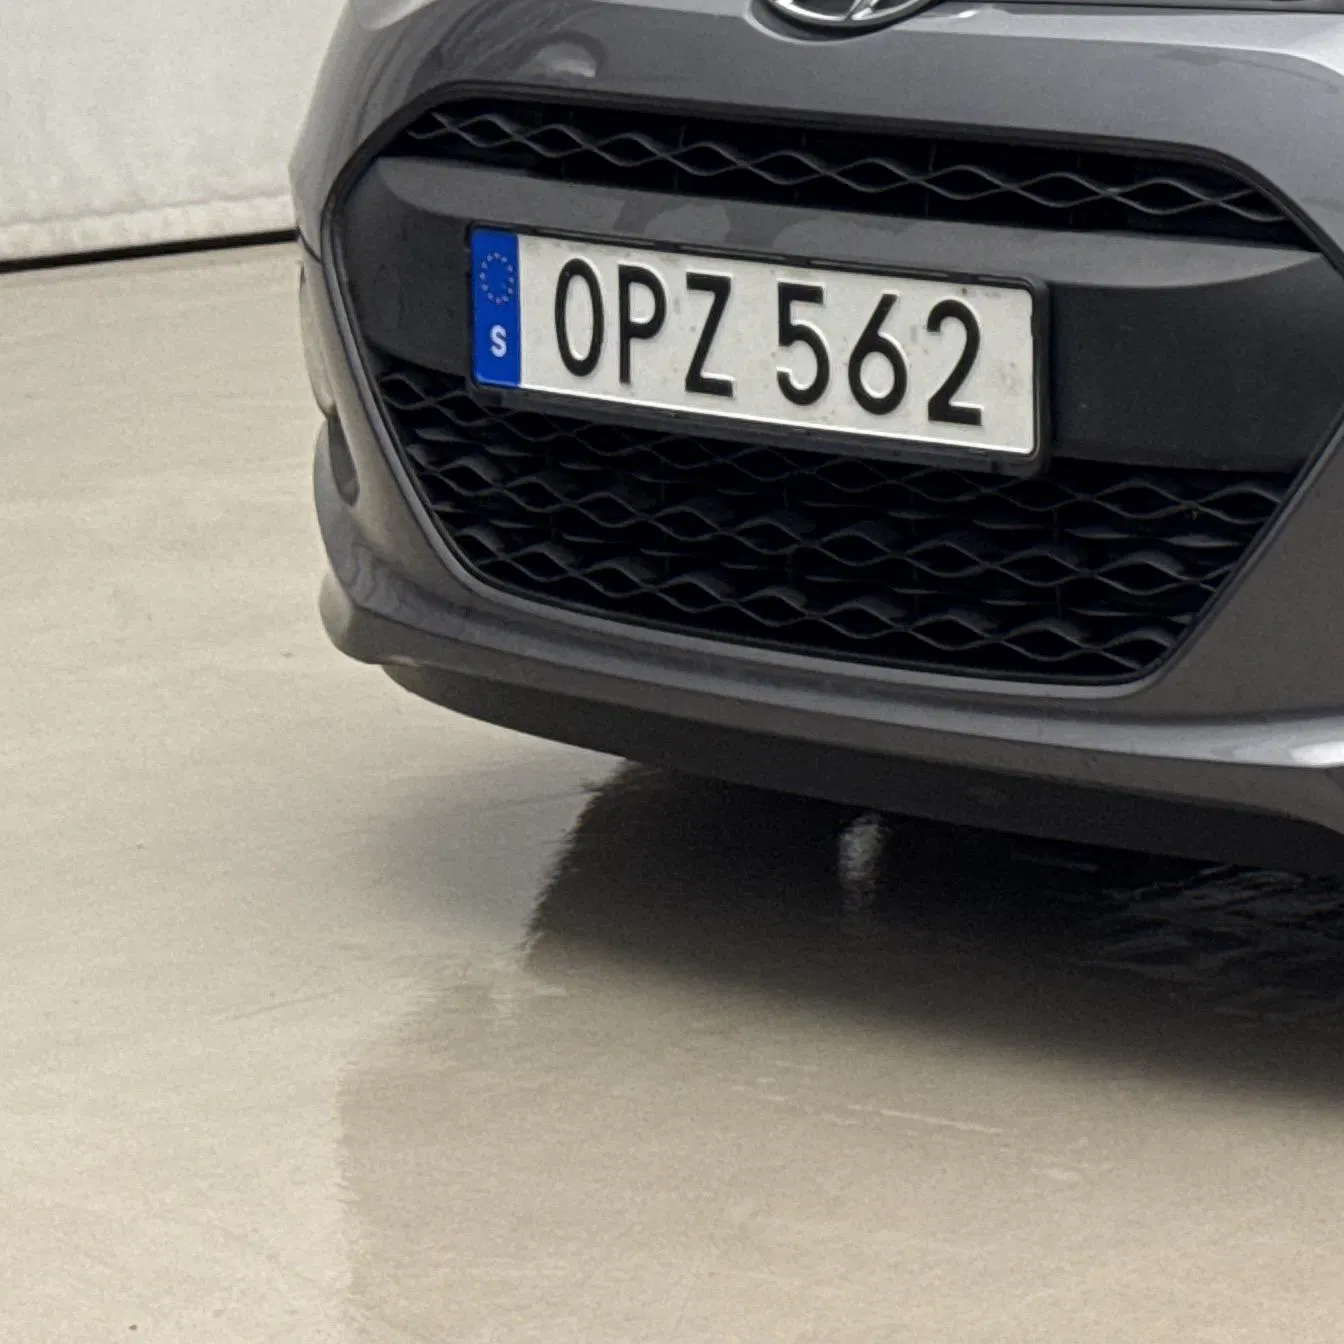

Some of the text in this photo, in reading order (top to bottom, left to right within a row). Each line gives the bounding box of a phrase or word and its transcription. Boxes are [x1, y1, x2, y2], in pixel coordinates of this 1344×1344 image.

[489, 324, 508, 358] S
[553, 256, 985, 426] OPZ 562
